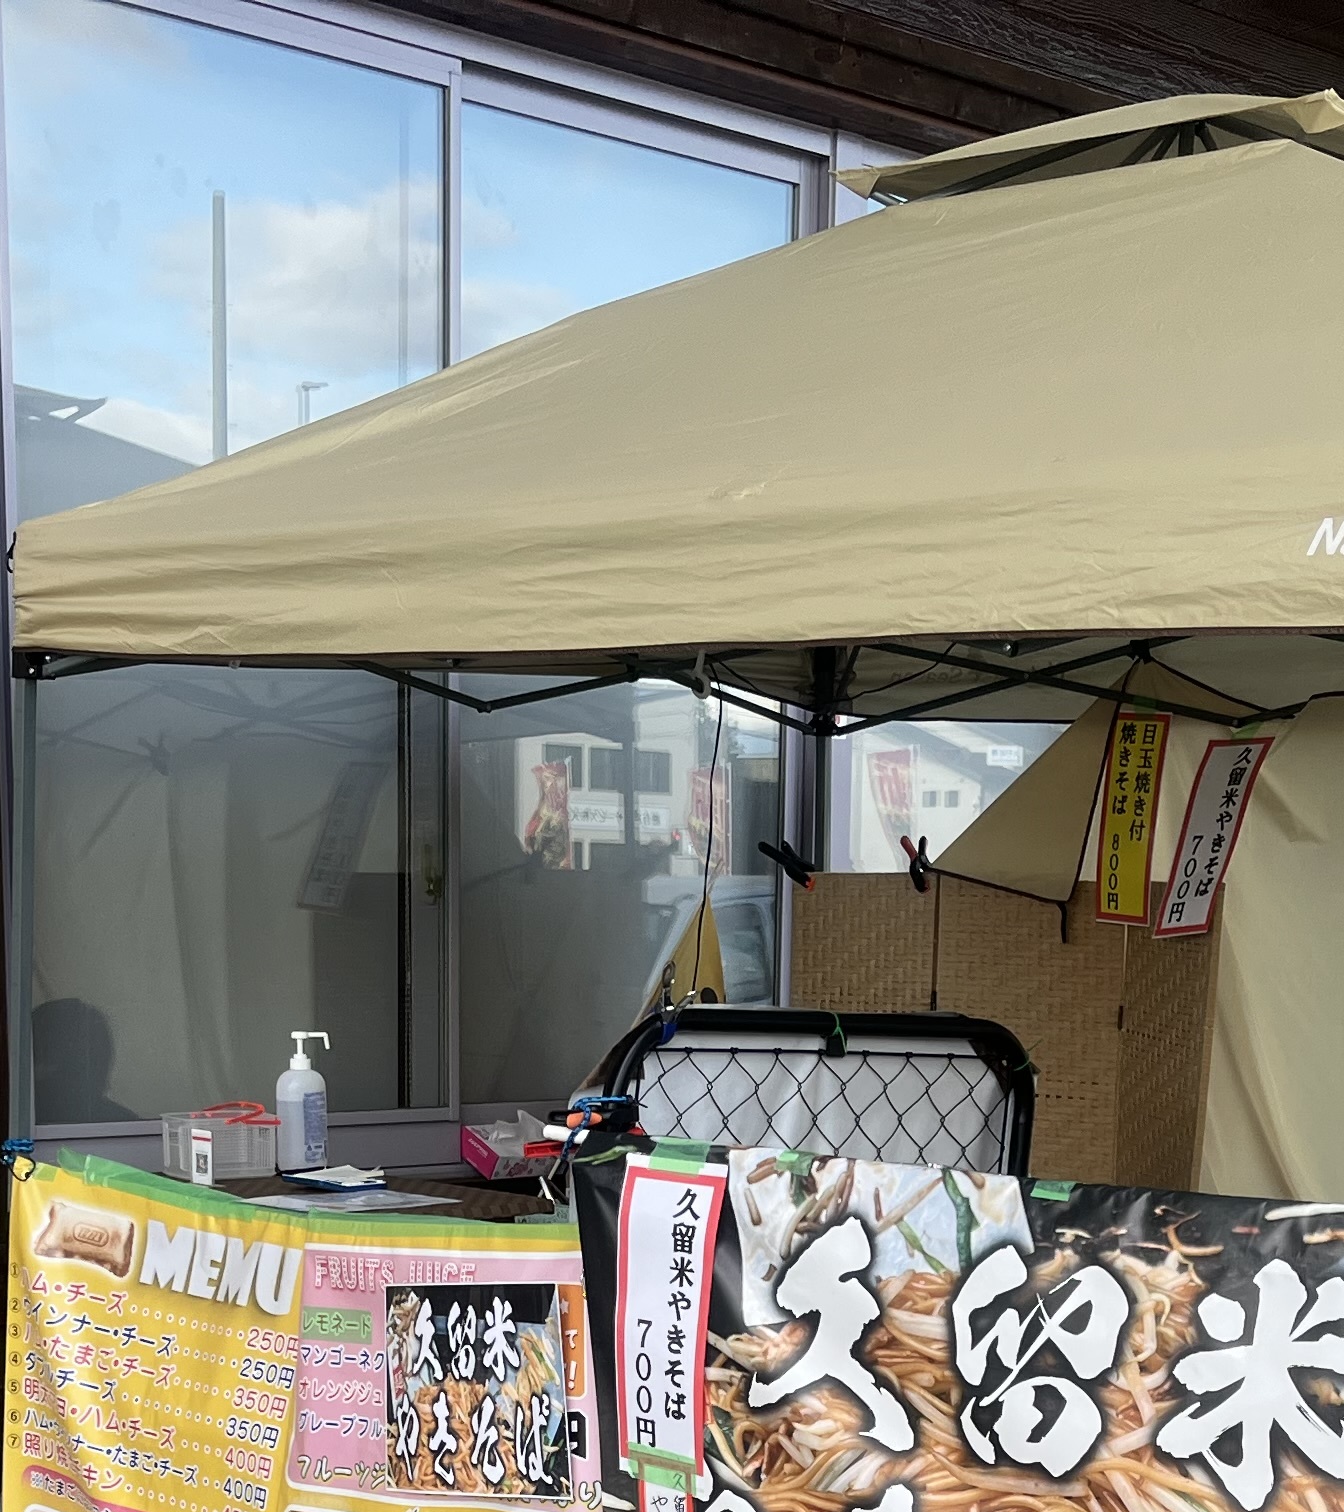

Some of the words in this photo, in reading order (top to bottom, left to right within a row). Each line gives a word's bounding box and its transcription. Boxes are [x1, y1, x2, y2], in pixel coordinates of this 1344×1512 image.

[1112, 722, 1137, 815] 焼きそば
[1129, 723, 1158, 842] 目玉焼き付
[1194, 747, 1252, 897] 久留米やきそば
[1107, 834, 1120, 911] 800円
[1168, 835, 1203, 923] 700円
[314, 1255, 394, 1292] FRUITS
[663, 1187, 700, 1421] 久留米やきそば
[247, 1328, 299, 1360] 250円
[302, 1311, 372, 1338] レモネード
[413, 1296, 520, 1382] 久留米
[233, 1387, 287, 1418] 350円
[239, 1358, 296, 1389] 250円
[635, 1318, 657, 1447] 700円
[225, 1448, 272, 1479] 400円
[226, 1417, 279, 1449] 350円
[395, 1391, 553, 1485] やきそば
[223, 1478, 267, 1509] 400円
